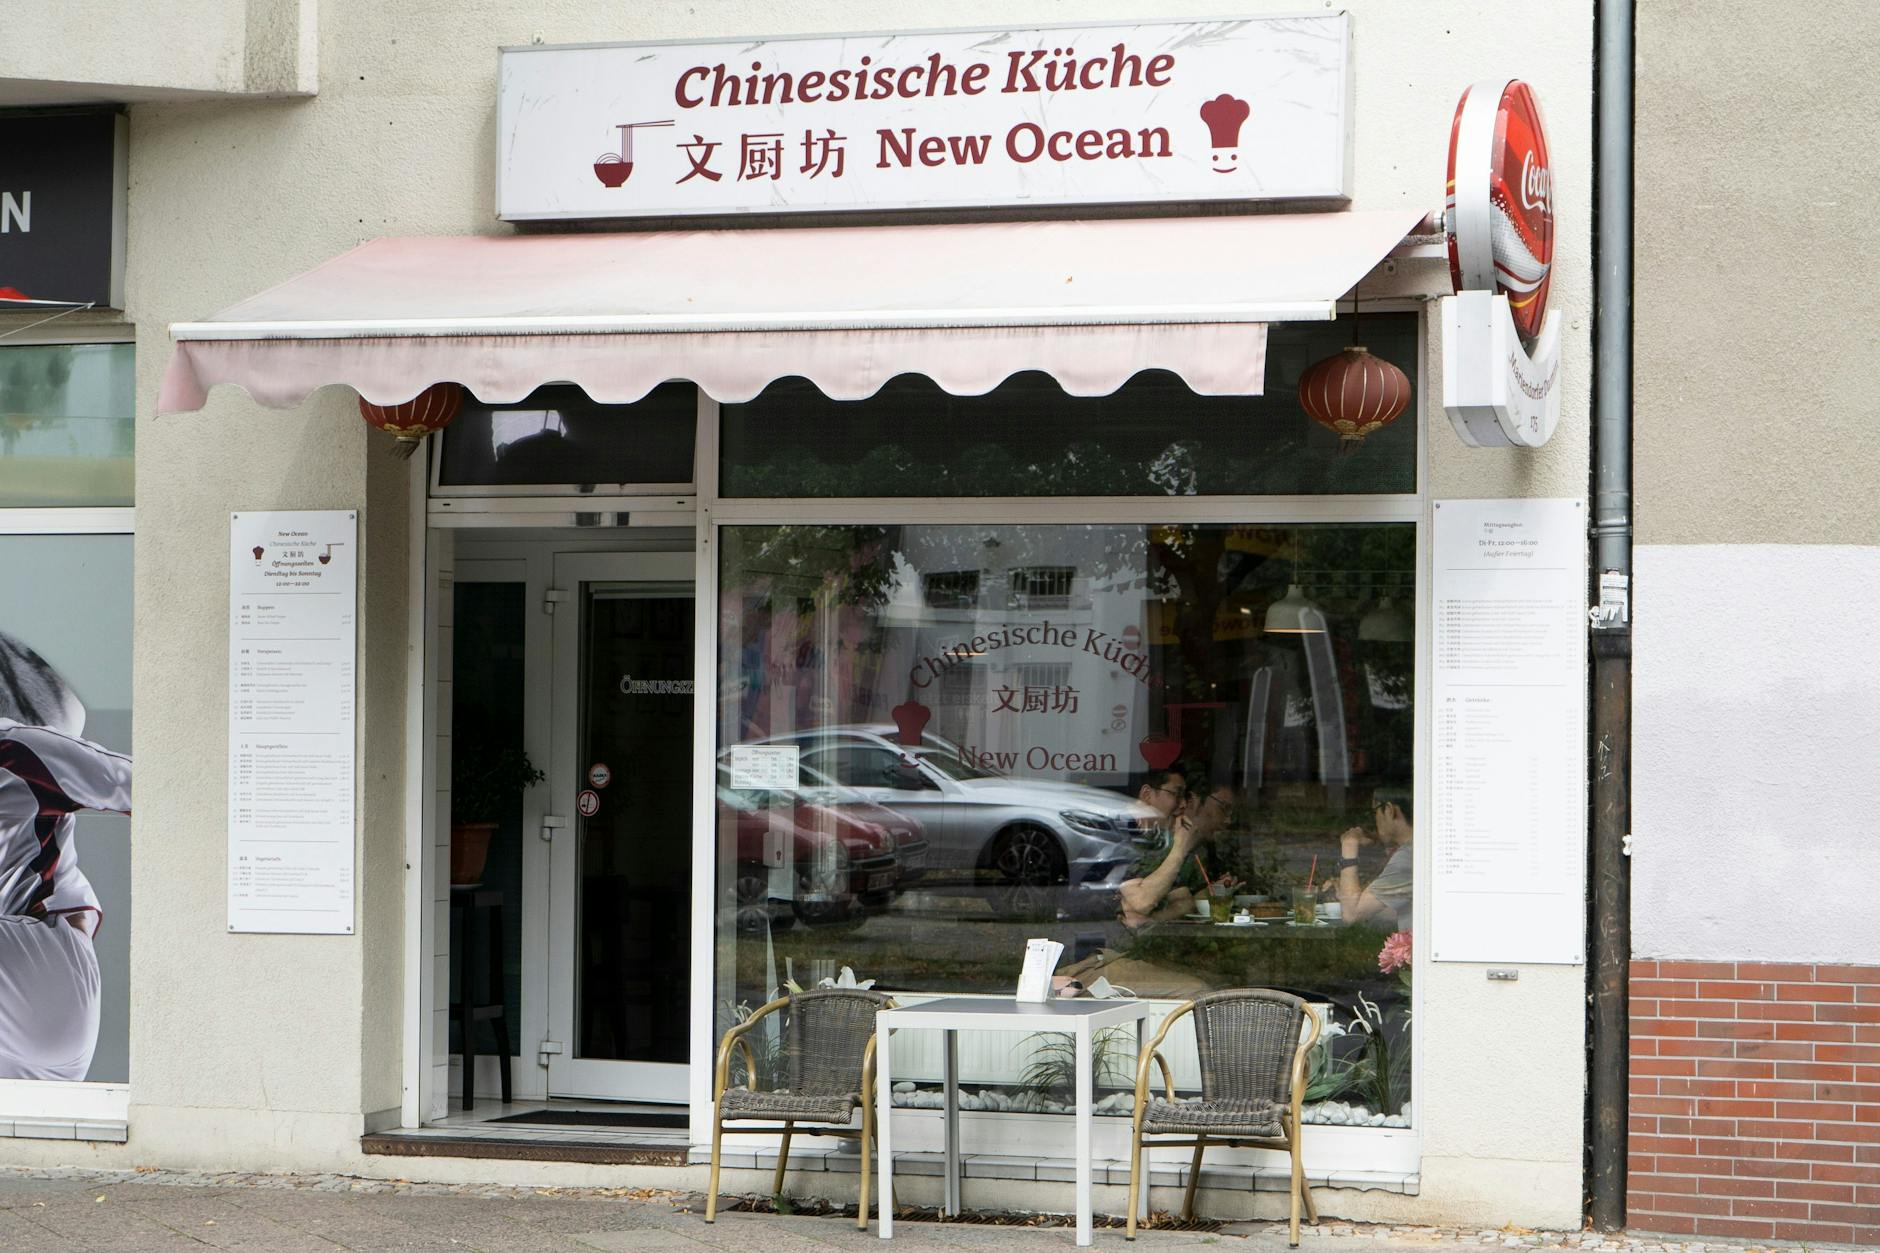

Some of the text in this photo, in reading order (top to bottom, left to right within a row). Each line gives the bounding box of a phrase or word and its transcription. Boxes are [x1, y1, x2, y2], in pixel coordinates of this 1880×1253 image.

[675, 43, 1175, 108] Chinesische Küche
[675, 122, 1173, 184] 文厨坊 New Ocean
[1, 191, 32, 233] N
[909, 620, 1078, 689] Chinesische
[991, 685, 1080, 714] 文厨坊
[957, 745, 1118, 772] New Ocean
